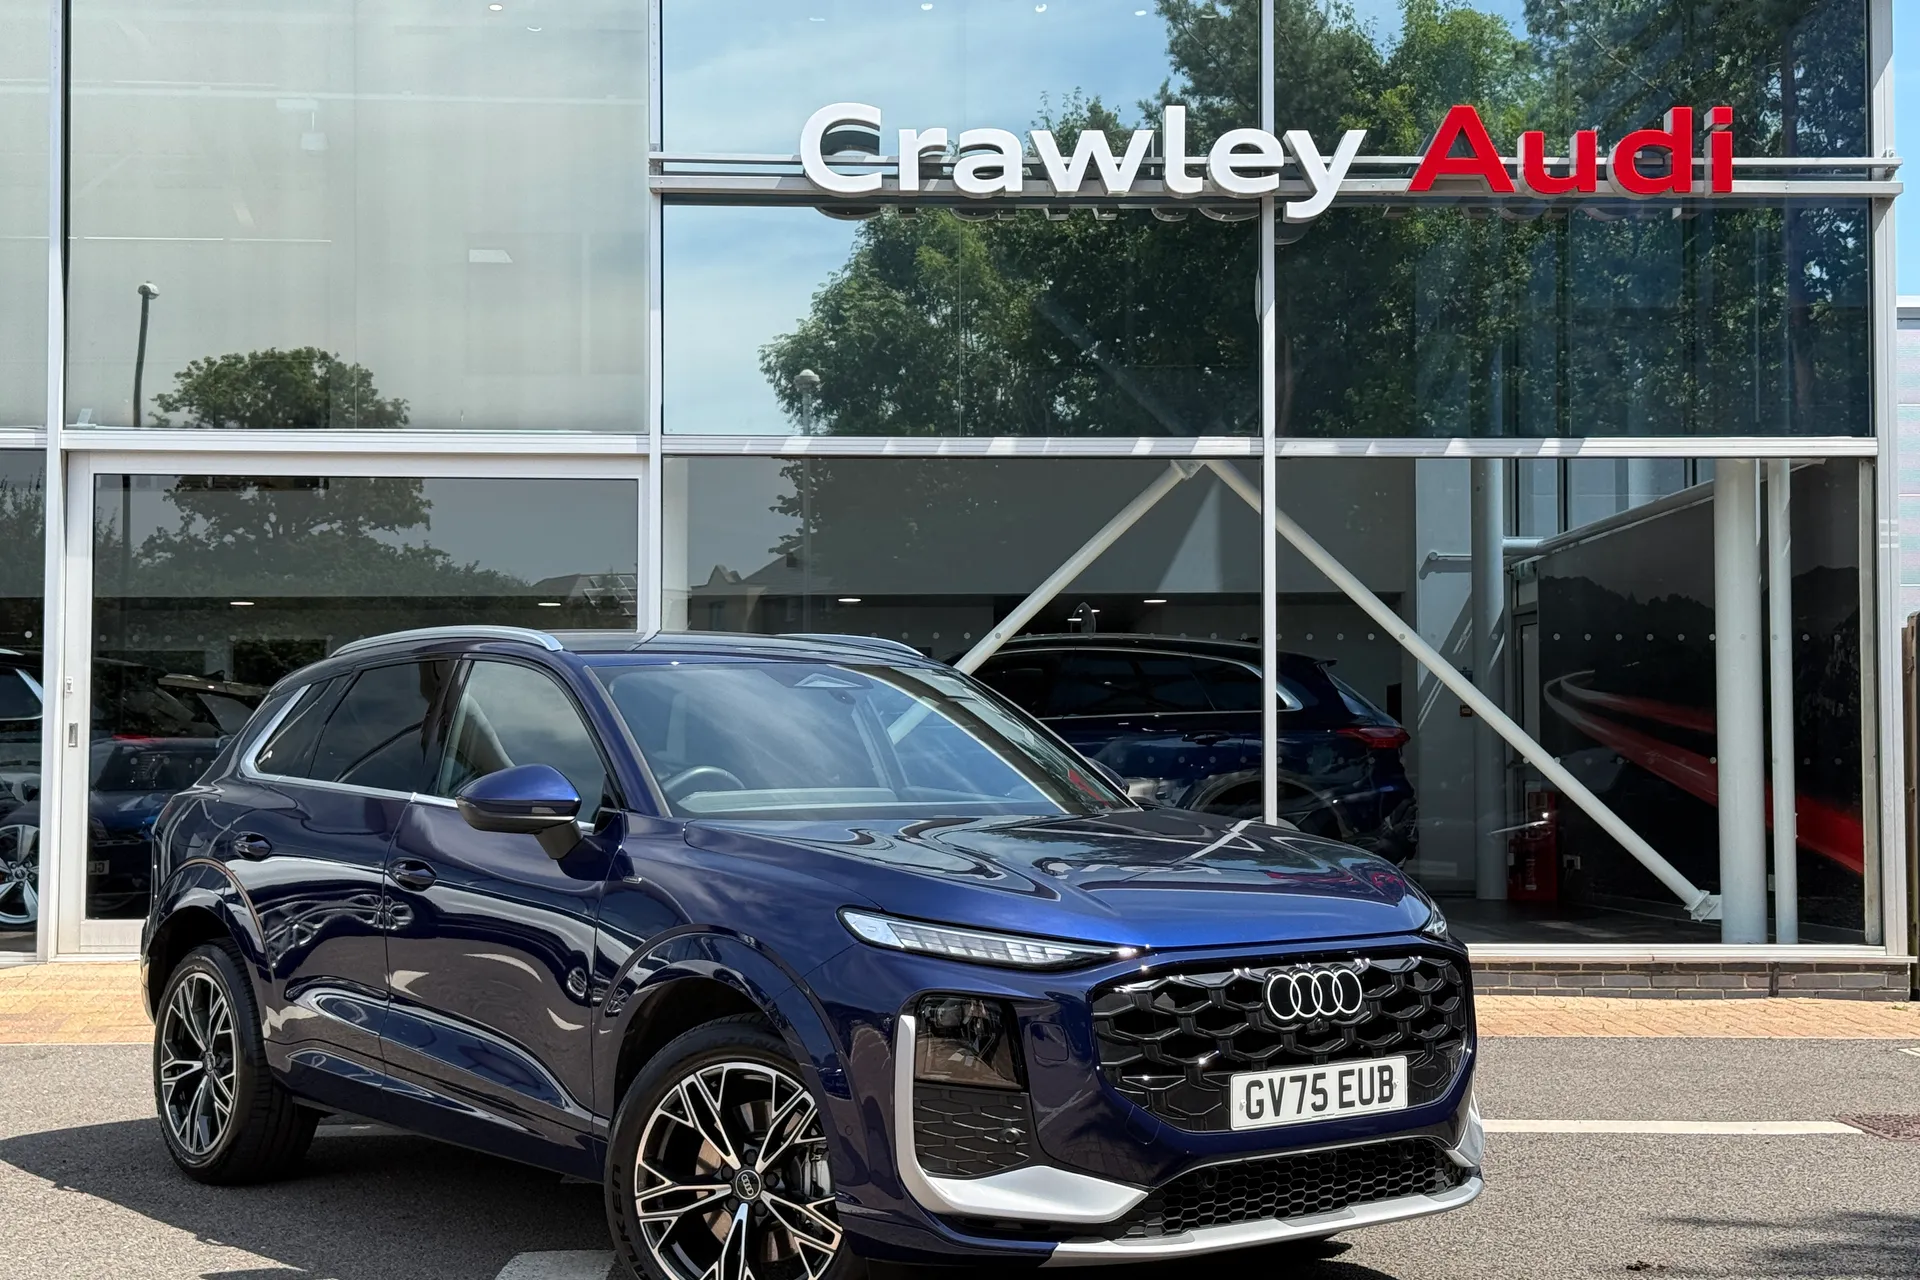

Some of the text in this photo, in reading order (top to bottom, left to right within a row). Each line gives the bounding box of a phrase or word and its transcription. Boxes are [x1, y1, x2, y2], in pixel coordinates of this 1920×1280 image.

[800, 102, 1734, 220] Crawley Audi
[1245, 1064, 1394, 1120] GV75 EUB
[611, 1163, 653, 1280] ALKEN
